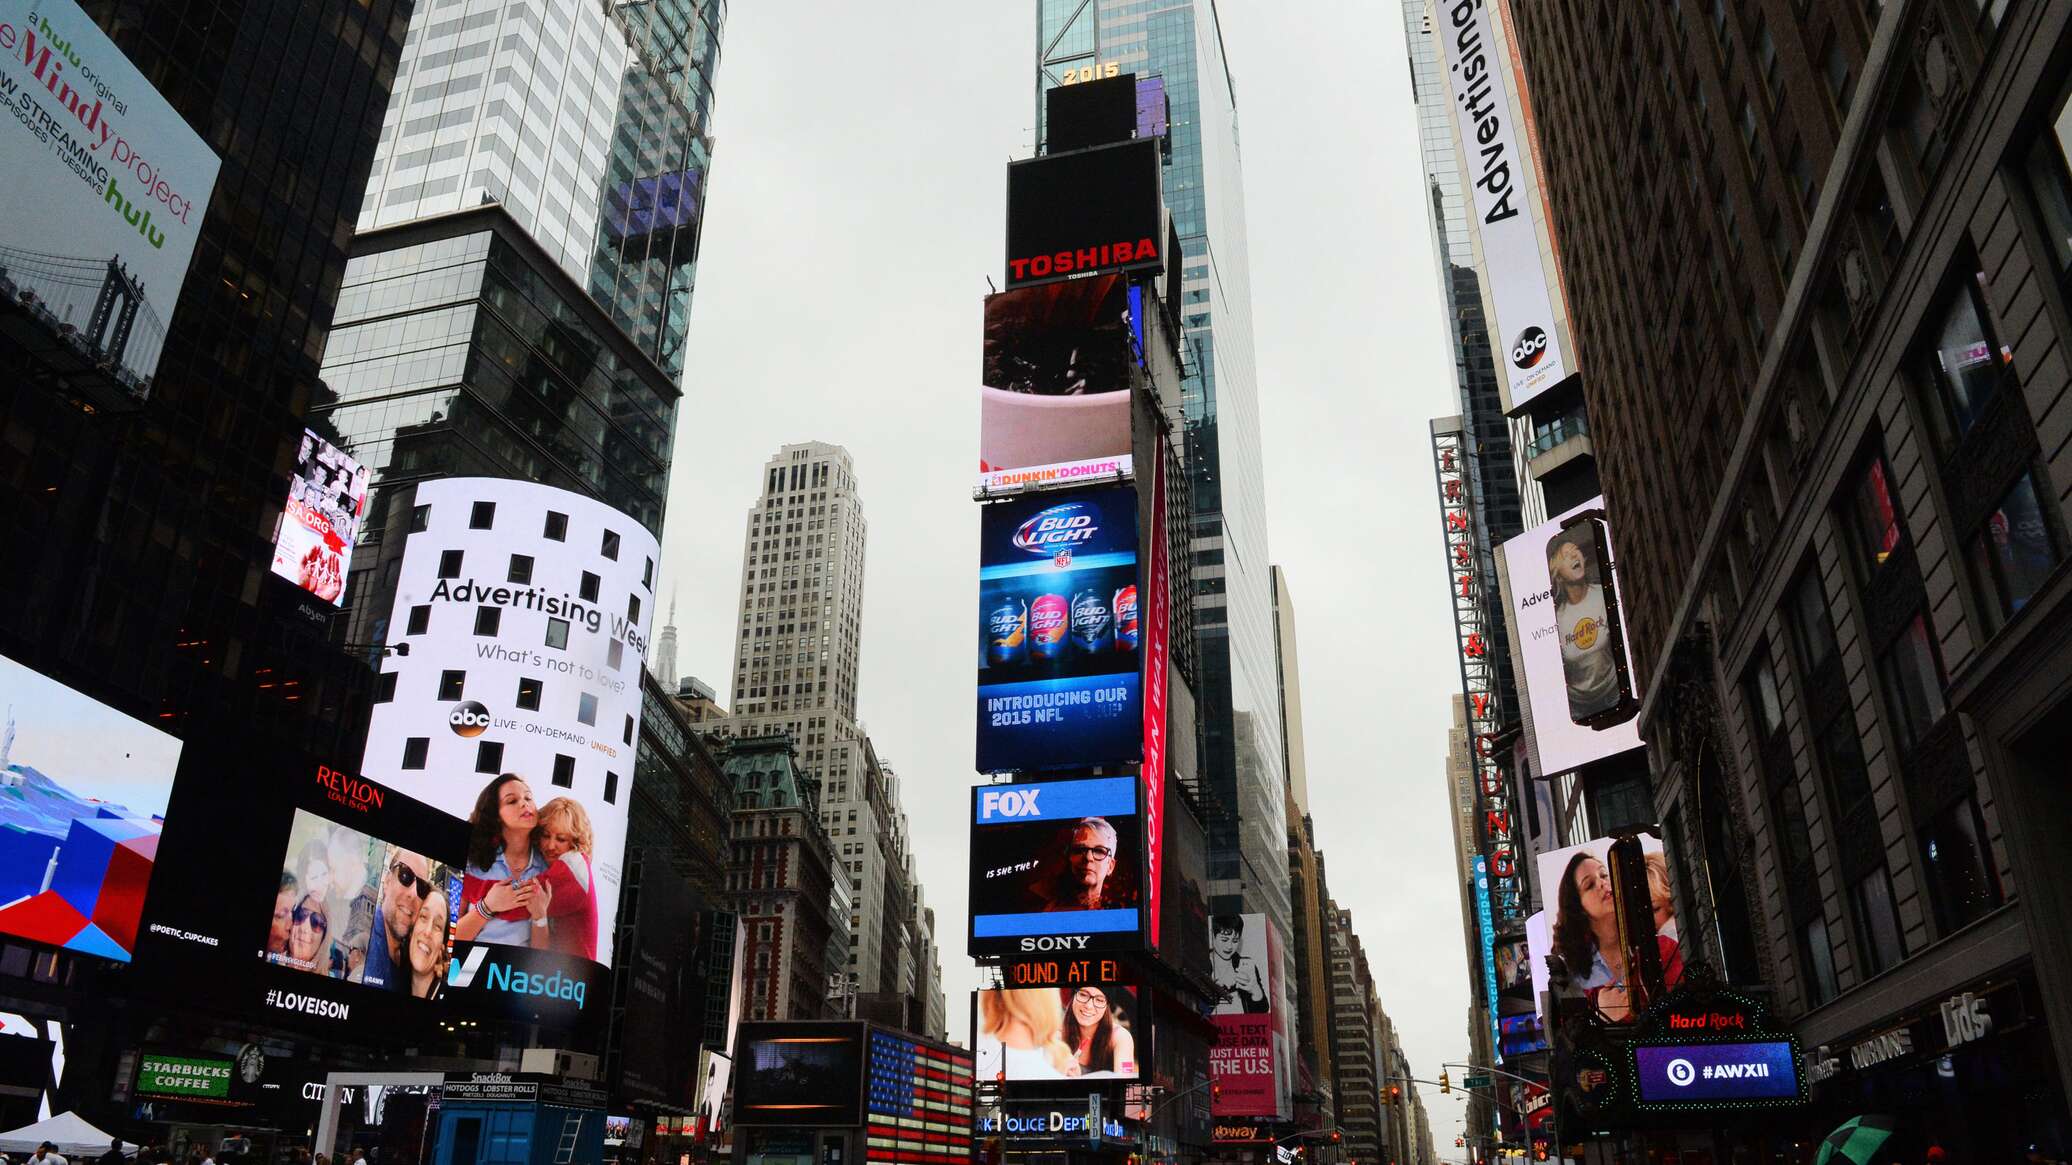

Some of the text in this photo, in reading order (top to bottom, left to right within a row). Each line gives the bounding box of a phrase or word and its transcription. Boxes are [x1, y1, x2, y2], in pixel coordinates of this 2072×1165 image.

[28, 11, 128, 117] a hulu original
[1063, 61, 1120, 85] 2015
[0, 67, 109, 185] W STREAMING
[14, 25, 118, 151] Mindy
[110, 136, 192, 225] project
[56, 146, 104, 195] TUESDAYS
[104, 176, 165, 249] hulu
[1009, 238, 1157, 280] TOSHIBA
[1067, 270, 1099, 280] TOSHIBA
[1512, 333, 1546, 362] abc
[1060, 462, 1117, 479] DONUTS
[1039, 515, 1091, 531] BUD
[1442, 448, 1473, 597] ERNST
[1026, 526, 1098, 546] LIGHT
[1056, 555, 1070, 566] NFL
[1155, 511, 1167, 630] CENTER
[298, 603, 326, 623] Absen
[429, 578, 648, 660] Advertising Week
[1031, 610, 1062, 622] BUD
[1075, 606, 1106, 619] BUD
[1565, 627, 1584, 645] Hard
[1585, 615, 1606, 632] Rock
[476, 642, 626, 696] What's not to love?
[1152, 632, 1164, 709] WAX
[988, 689, 1091, 712] INTRODUCING
[1094, 687, 1128, 703] OUR
[449, 708, 490, 726] abc
[992, 711, 1032, 727] 2015
[1035, 708, 1064, 723] NFL
[494, 717, 617, 758] LIVE ON-DEMAND UNIFIED
[316, 764, 385, 809] REVLON
[327, 789, 349, 807] LOVE
[982, 788, 1040, 819] FOX
[986, 870, 995, 879] IS
[996, 865, 1012, 877] SHE
[1014, 861, 1031, 872] THE
[149, 922, 219, 947] @POETIC_CUPCAKES
[1020, 935, 1091, 952] SONY
[1013, 962, 1058, 984] OUND
[1068, 961, 1090, 982] AT
[486, 962, 586, 1010] Nasdaq
[265, 988, 350, 1021] #LOVEISON
[1240, 1024, 1268, 1035] TEXT
[1670, 1012, 1745, 1030] Hard Rock
[1941, 992, 1992, 1048] Lids
[1210, 1047, 1269, 1059] JUST LIKE IN
[1241, 1036, 1268, 1047] DATA
[143, 1061, 231, 1078] STARBUCKS
[471, 1072, 512, 1084] SnackBox
[1210, 1058, 1273, 1075] THE U.S.
[1702, 1063, 1769, 1079] #AWXII
[155, 1075, 210, 1090] COFFEE
[445, 1084, 536, 1094] HOTDOGS LOBSTER ROLLS
[1091, 1095, 1099, 1139] NYPD
